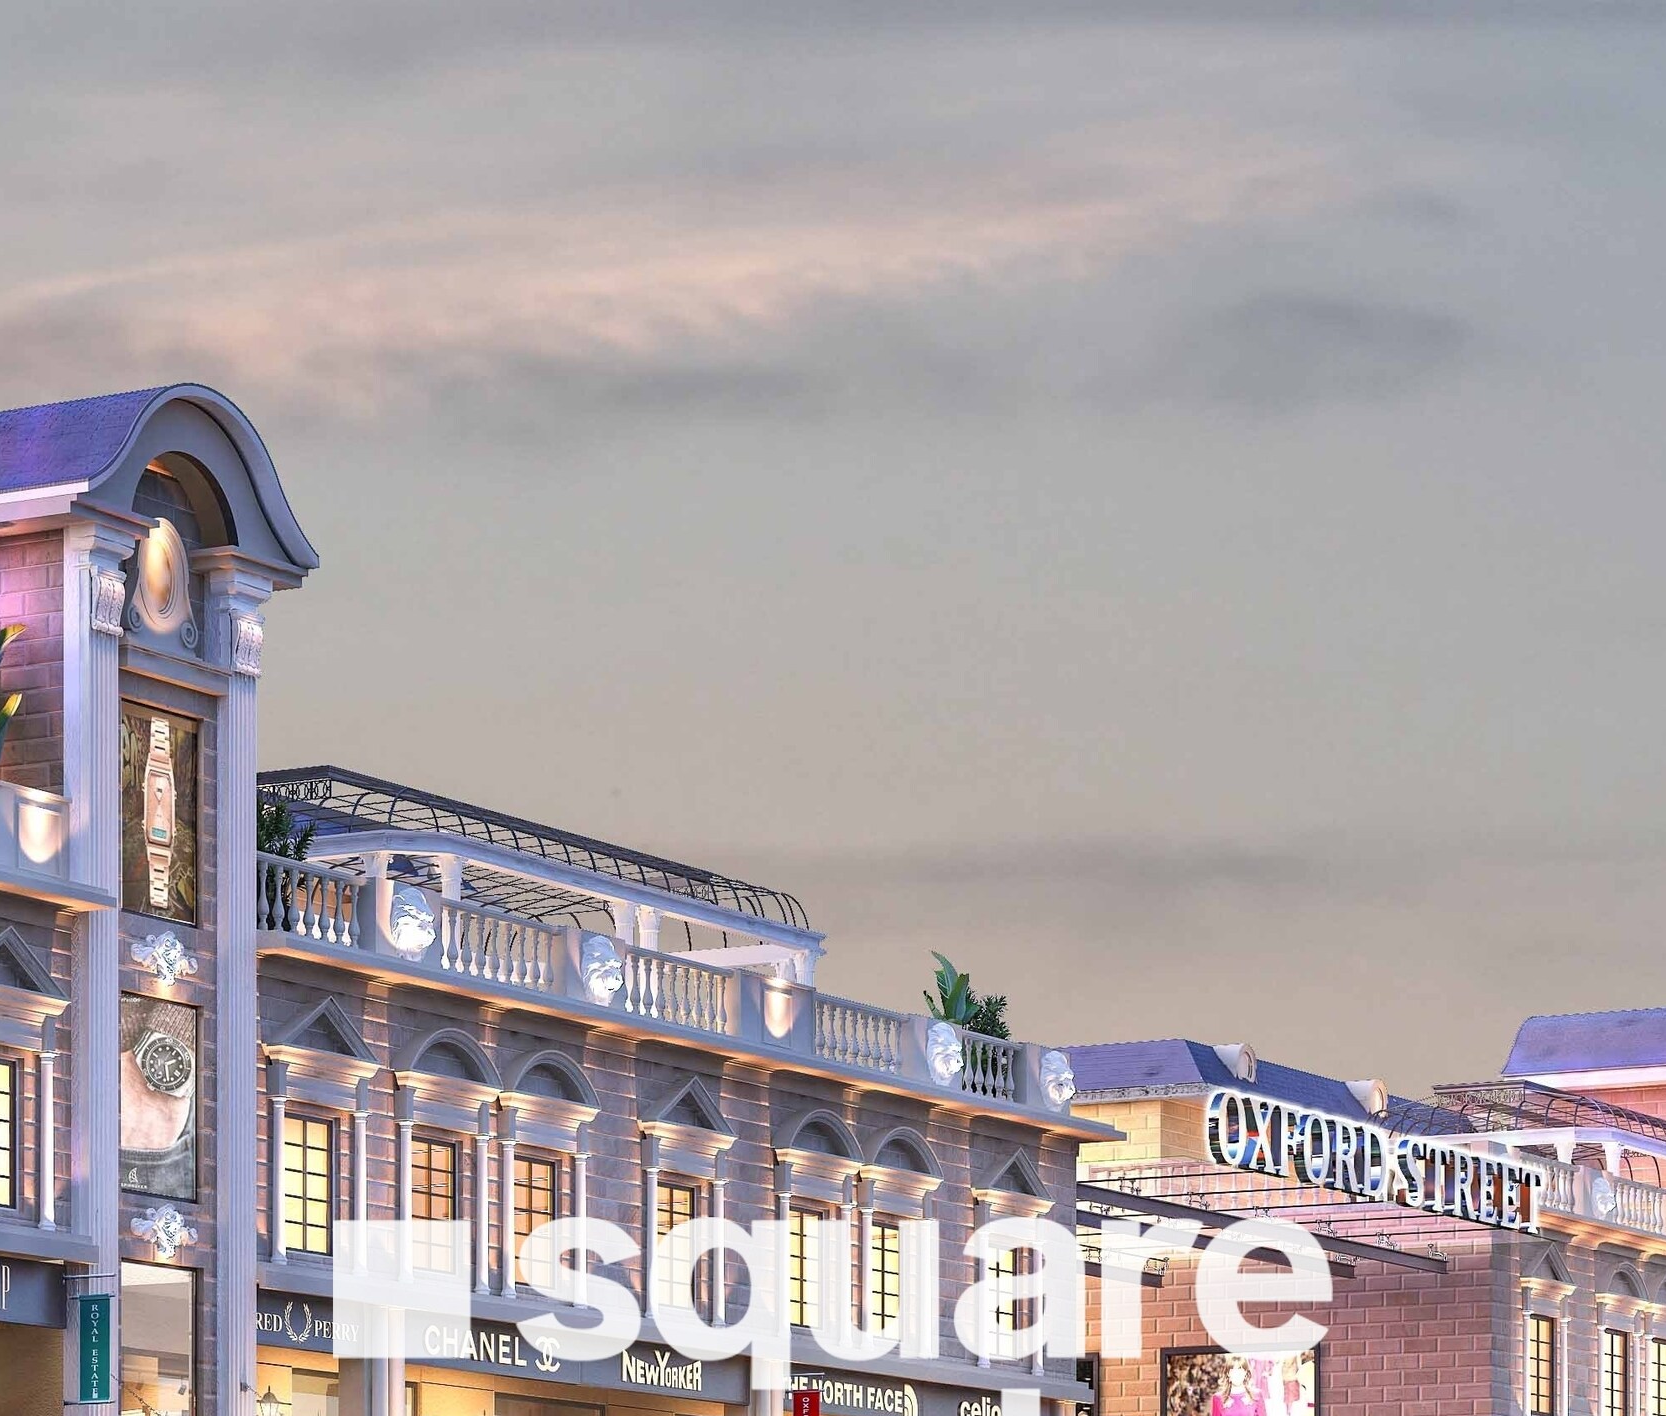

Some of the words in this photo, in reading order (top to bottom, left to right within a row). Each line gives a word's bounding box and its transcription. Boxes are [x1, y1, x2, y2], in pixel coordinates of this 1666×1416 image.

[1209, 1092, 1389, 1199] OXFORD
[1396, 1135, 1545, 1235] STREET
[90, 1304, 99, 1343] ROYAL
[314, 1318, 361, 1343] PERRY
[424, 1325, 528, 1367] CHANEL
[91, 1349, 99, 1399] ESTATE
[811, 1379, 863, 1409] NORTH
[867, 1387, 903, 1414] FACE
